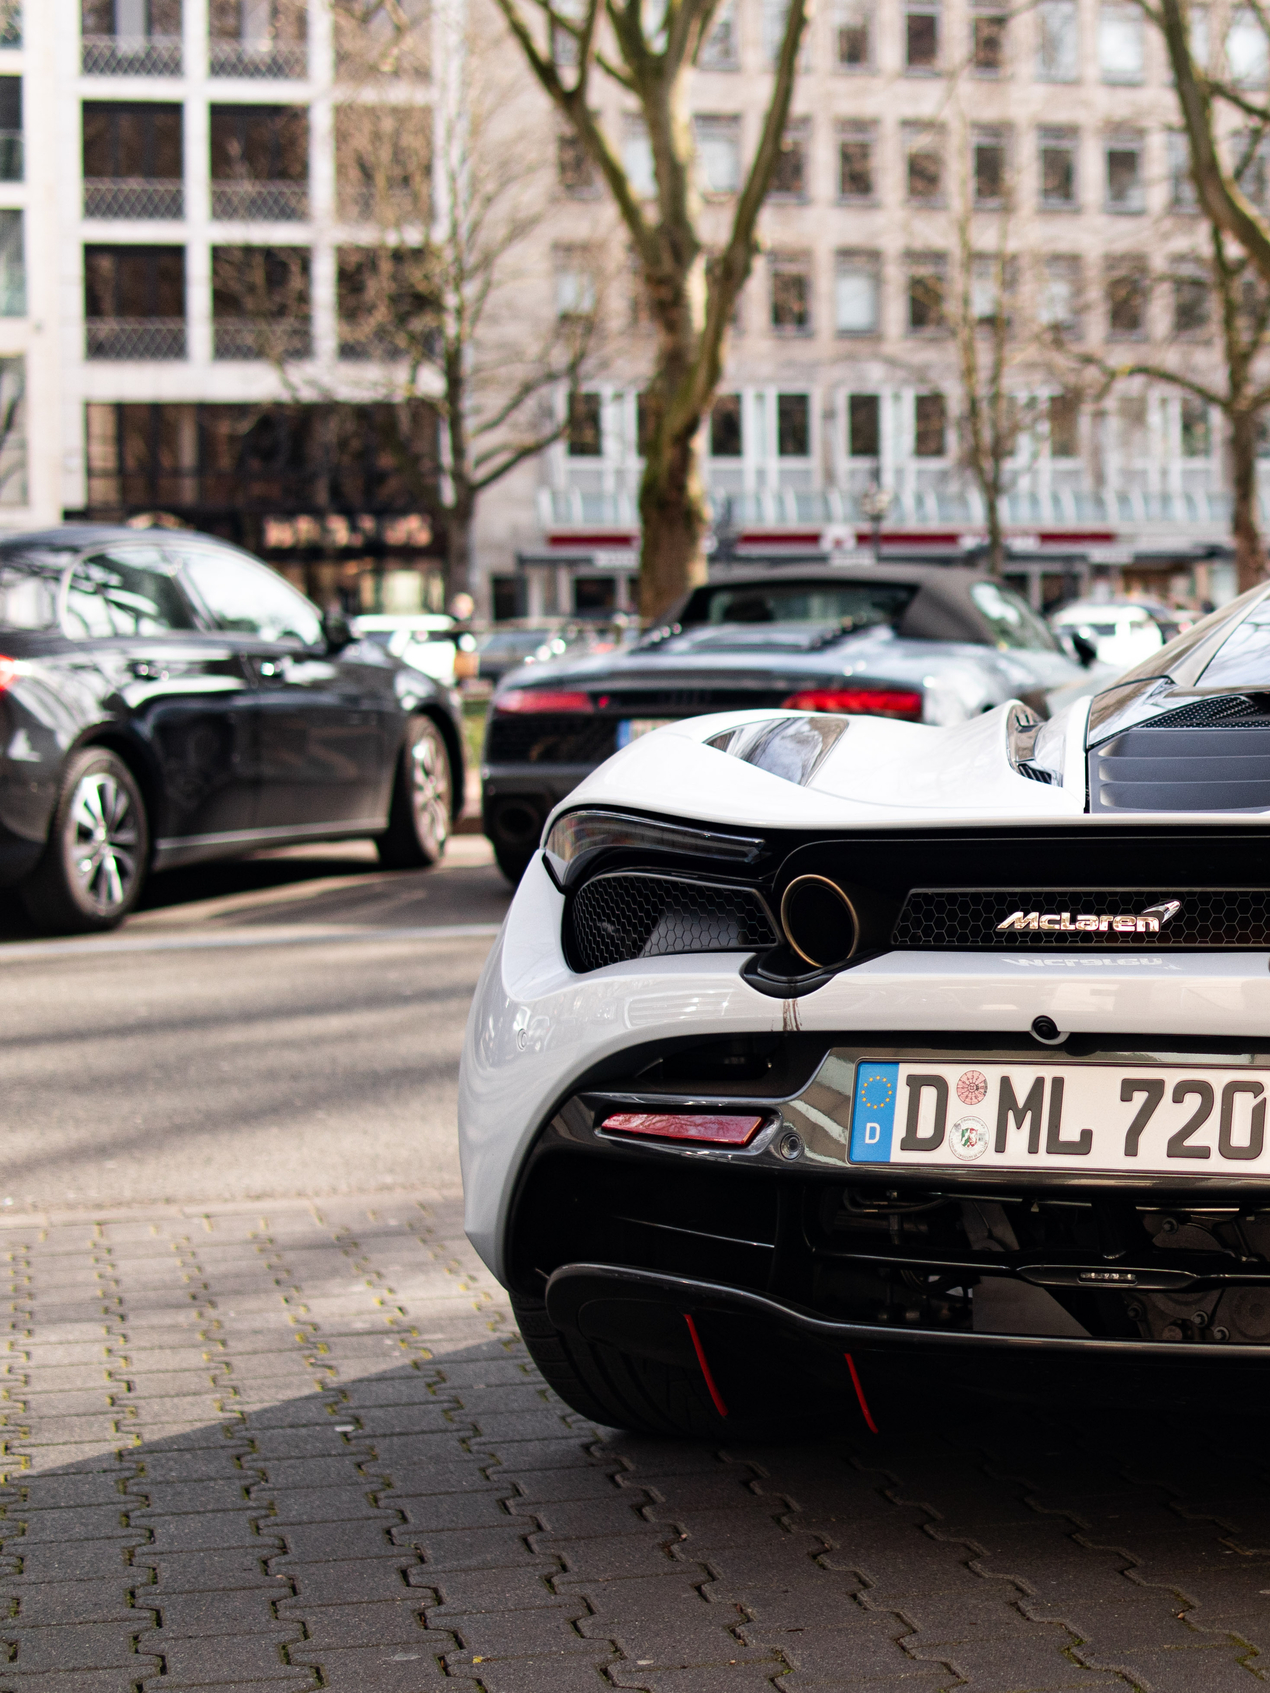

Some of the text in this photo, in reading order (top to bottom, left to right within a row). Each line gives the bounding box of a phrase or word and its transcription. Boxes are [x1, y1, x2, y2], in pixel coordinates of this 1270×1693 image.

[997, 911, 1160, 932] McLaren
[900, 1074, 949, 1151] D
[995, 1076, 1093, 1155] ML
[1120, 1079, 1266, 1159] 720
[865, 1122, 880, 1144] D
